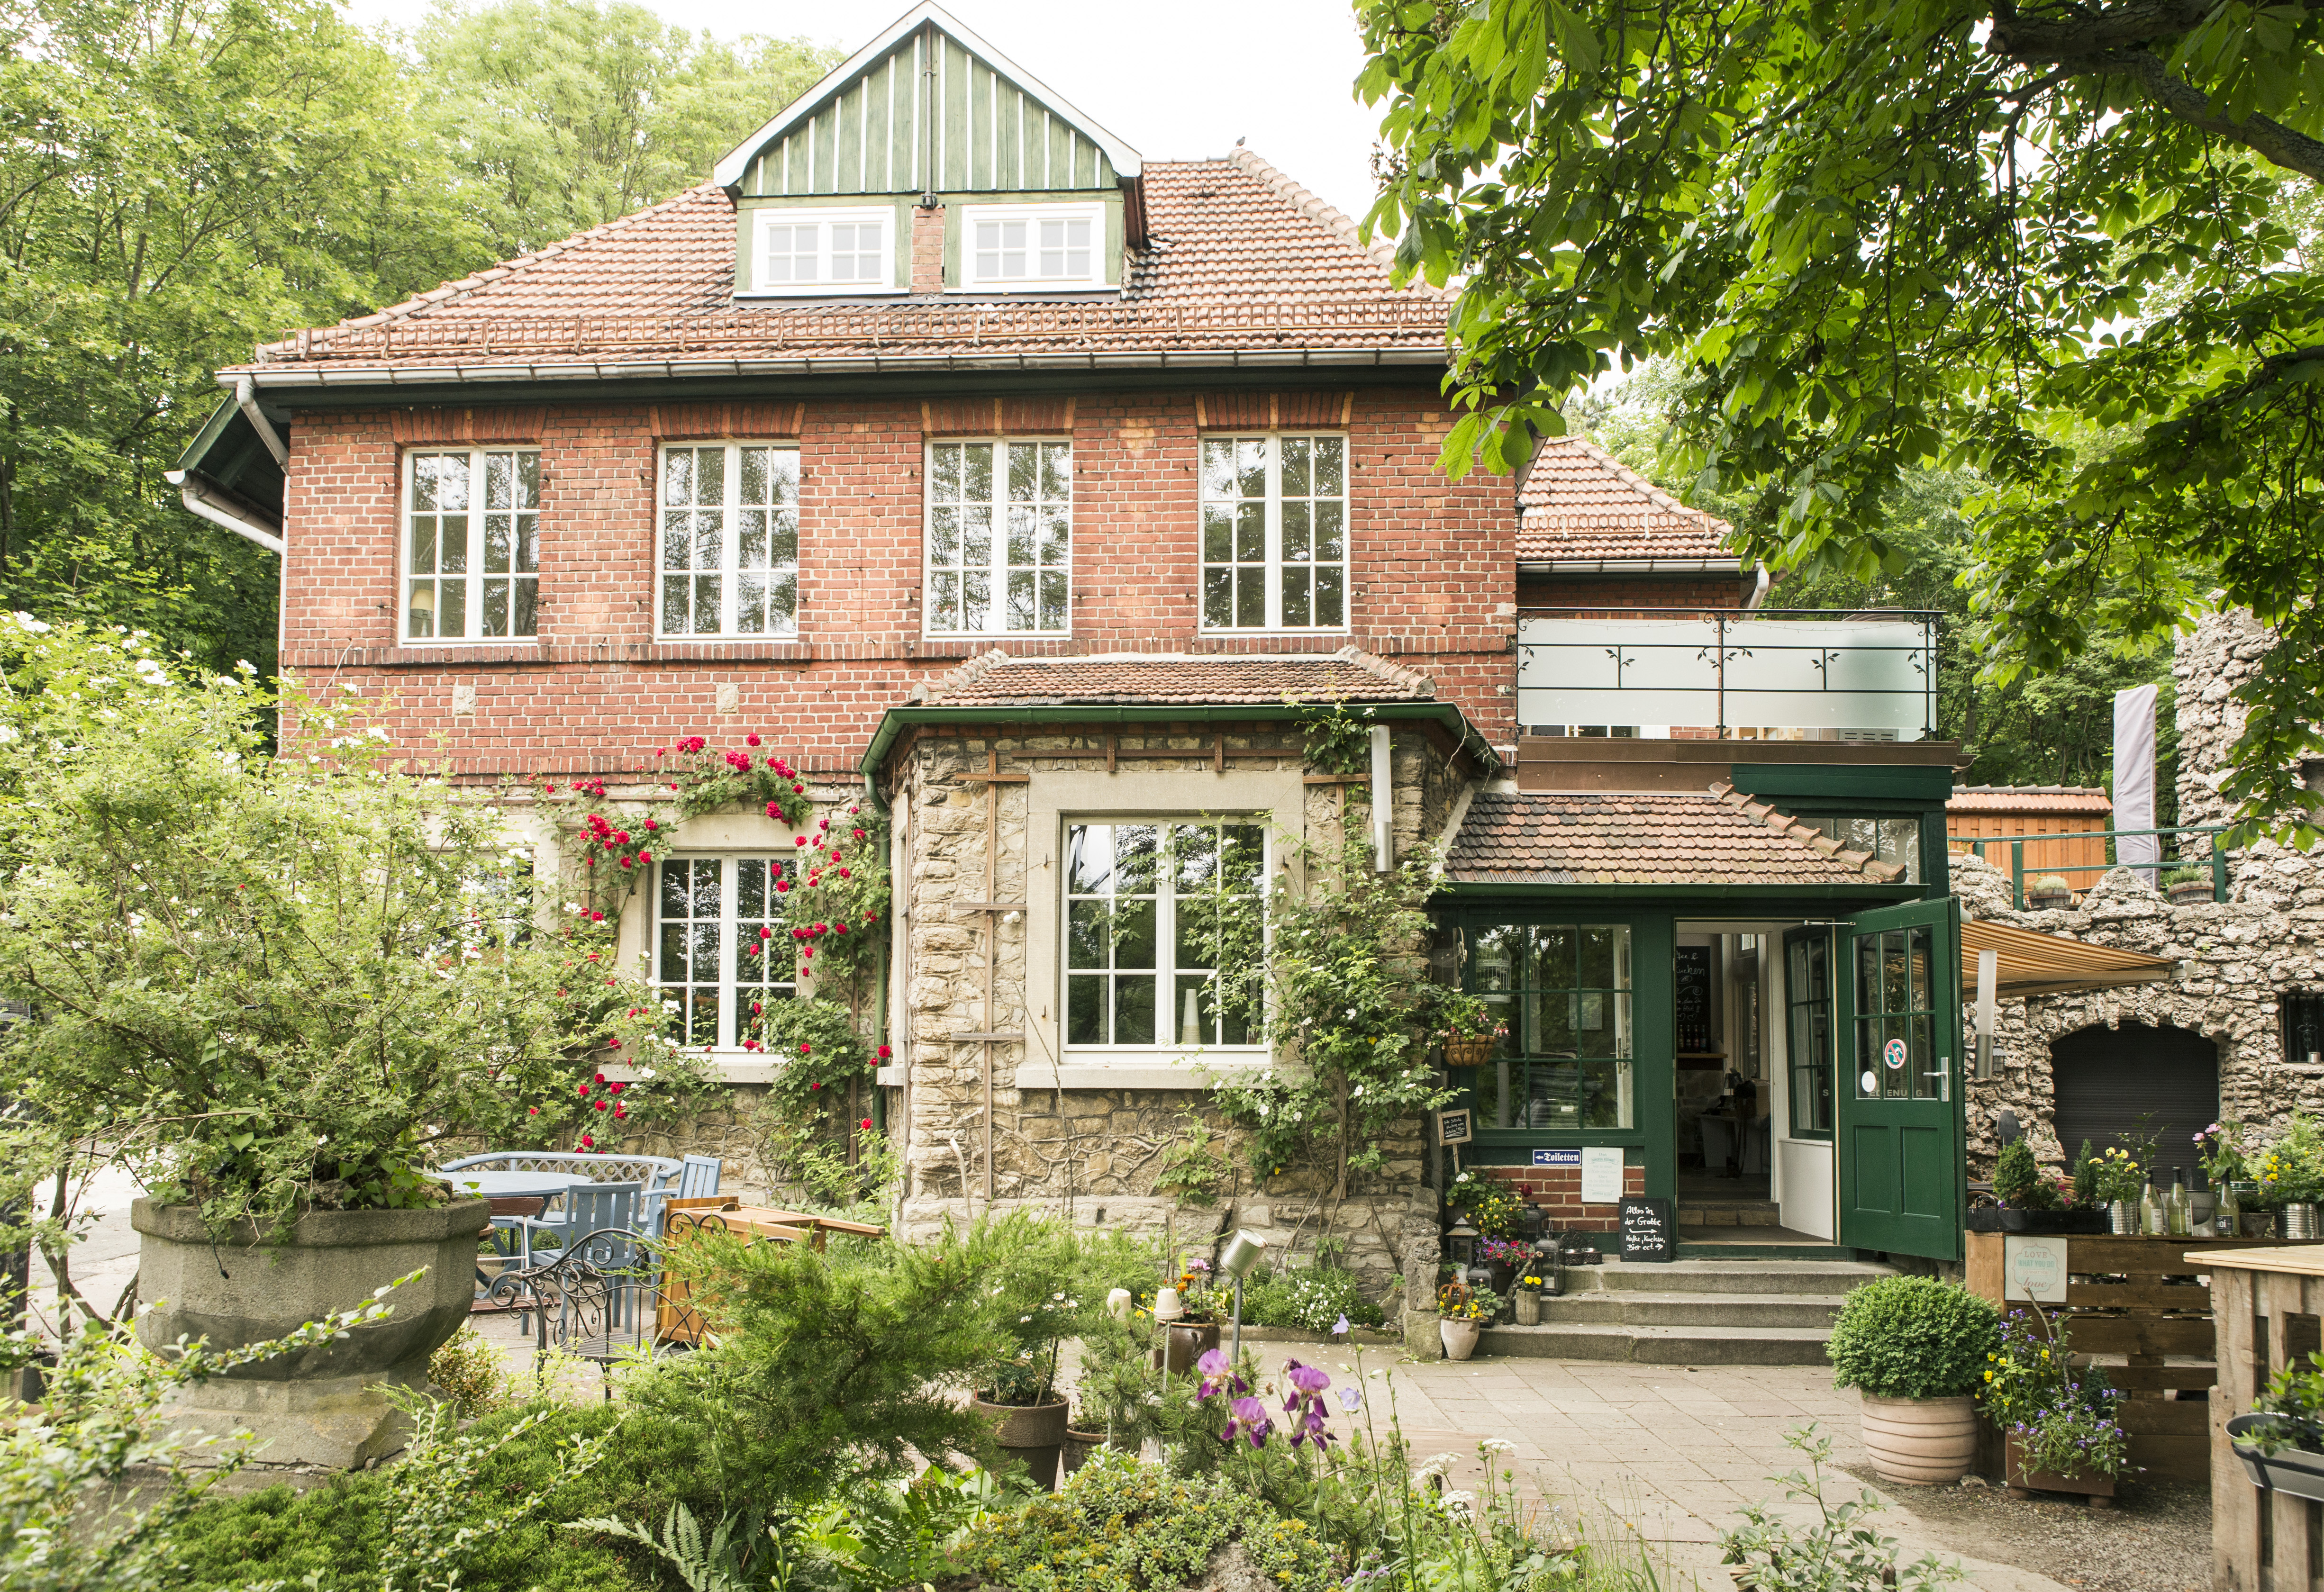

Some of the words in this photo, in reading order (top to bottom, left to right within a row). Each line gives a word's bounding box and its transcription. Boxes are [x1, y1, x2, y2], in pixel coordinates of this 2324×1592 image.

[1543, 1152, 1579, 1162] Toiletten
[1626, 1206, 1644, 1214] Alles
[1645, 1207, 1654, 1215] in
[1625, 1217, 1635, 1225] der
[1637, 1216, 1661, 1226] Grotte
[2023, 1276, 2047, 1288] love
